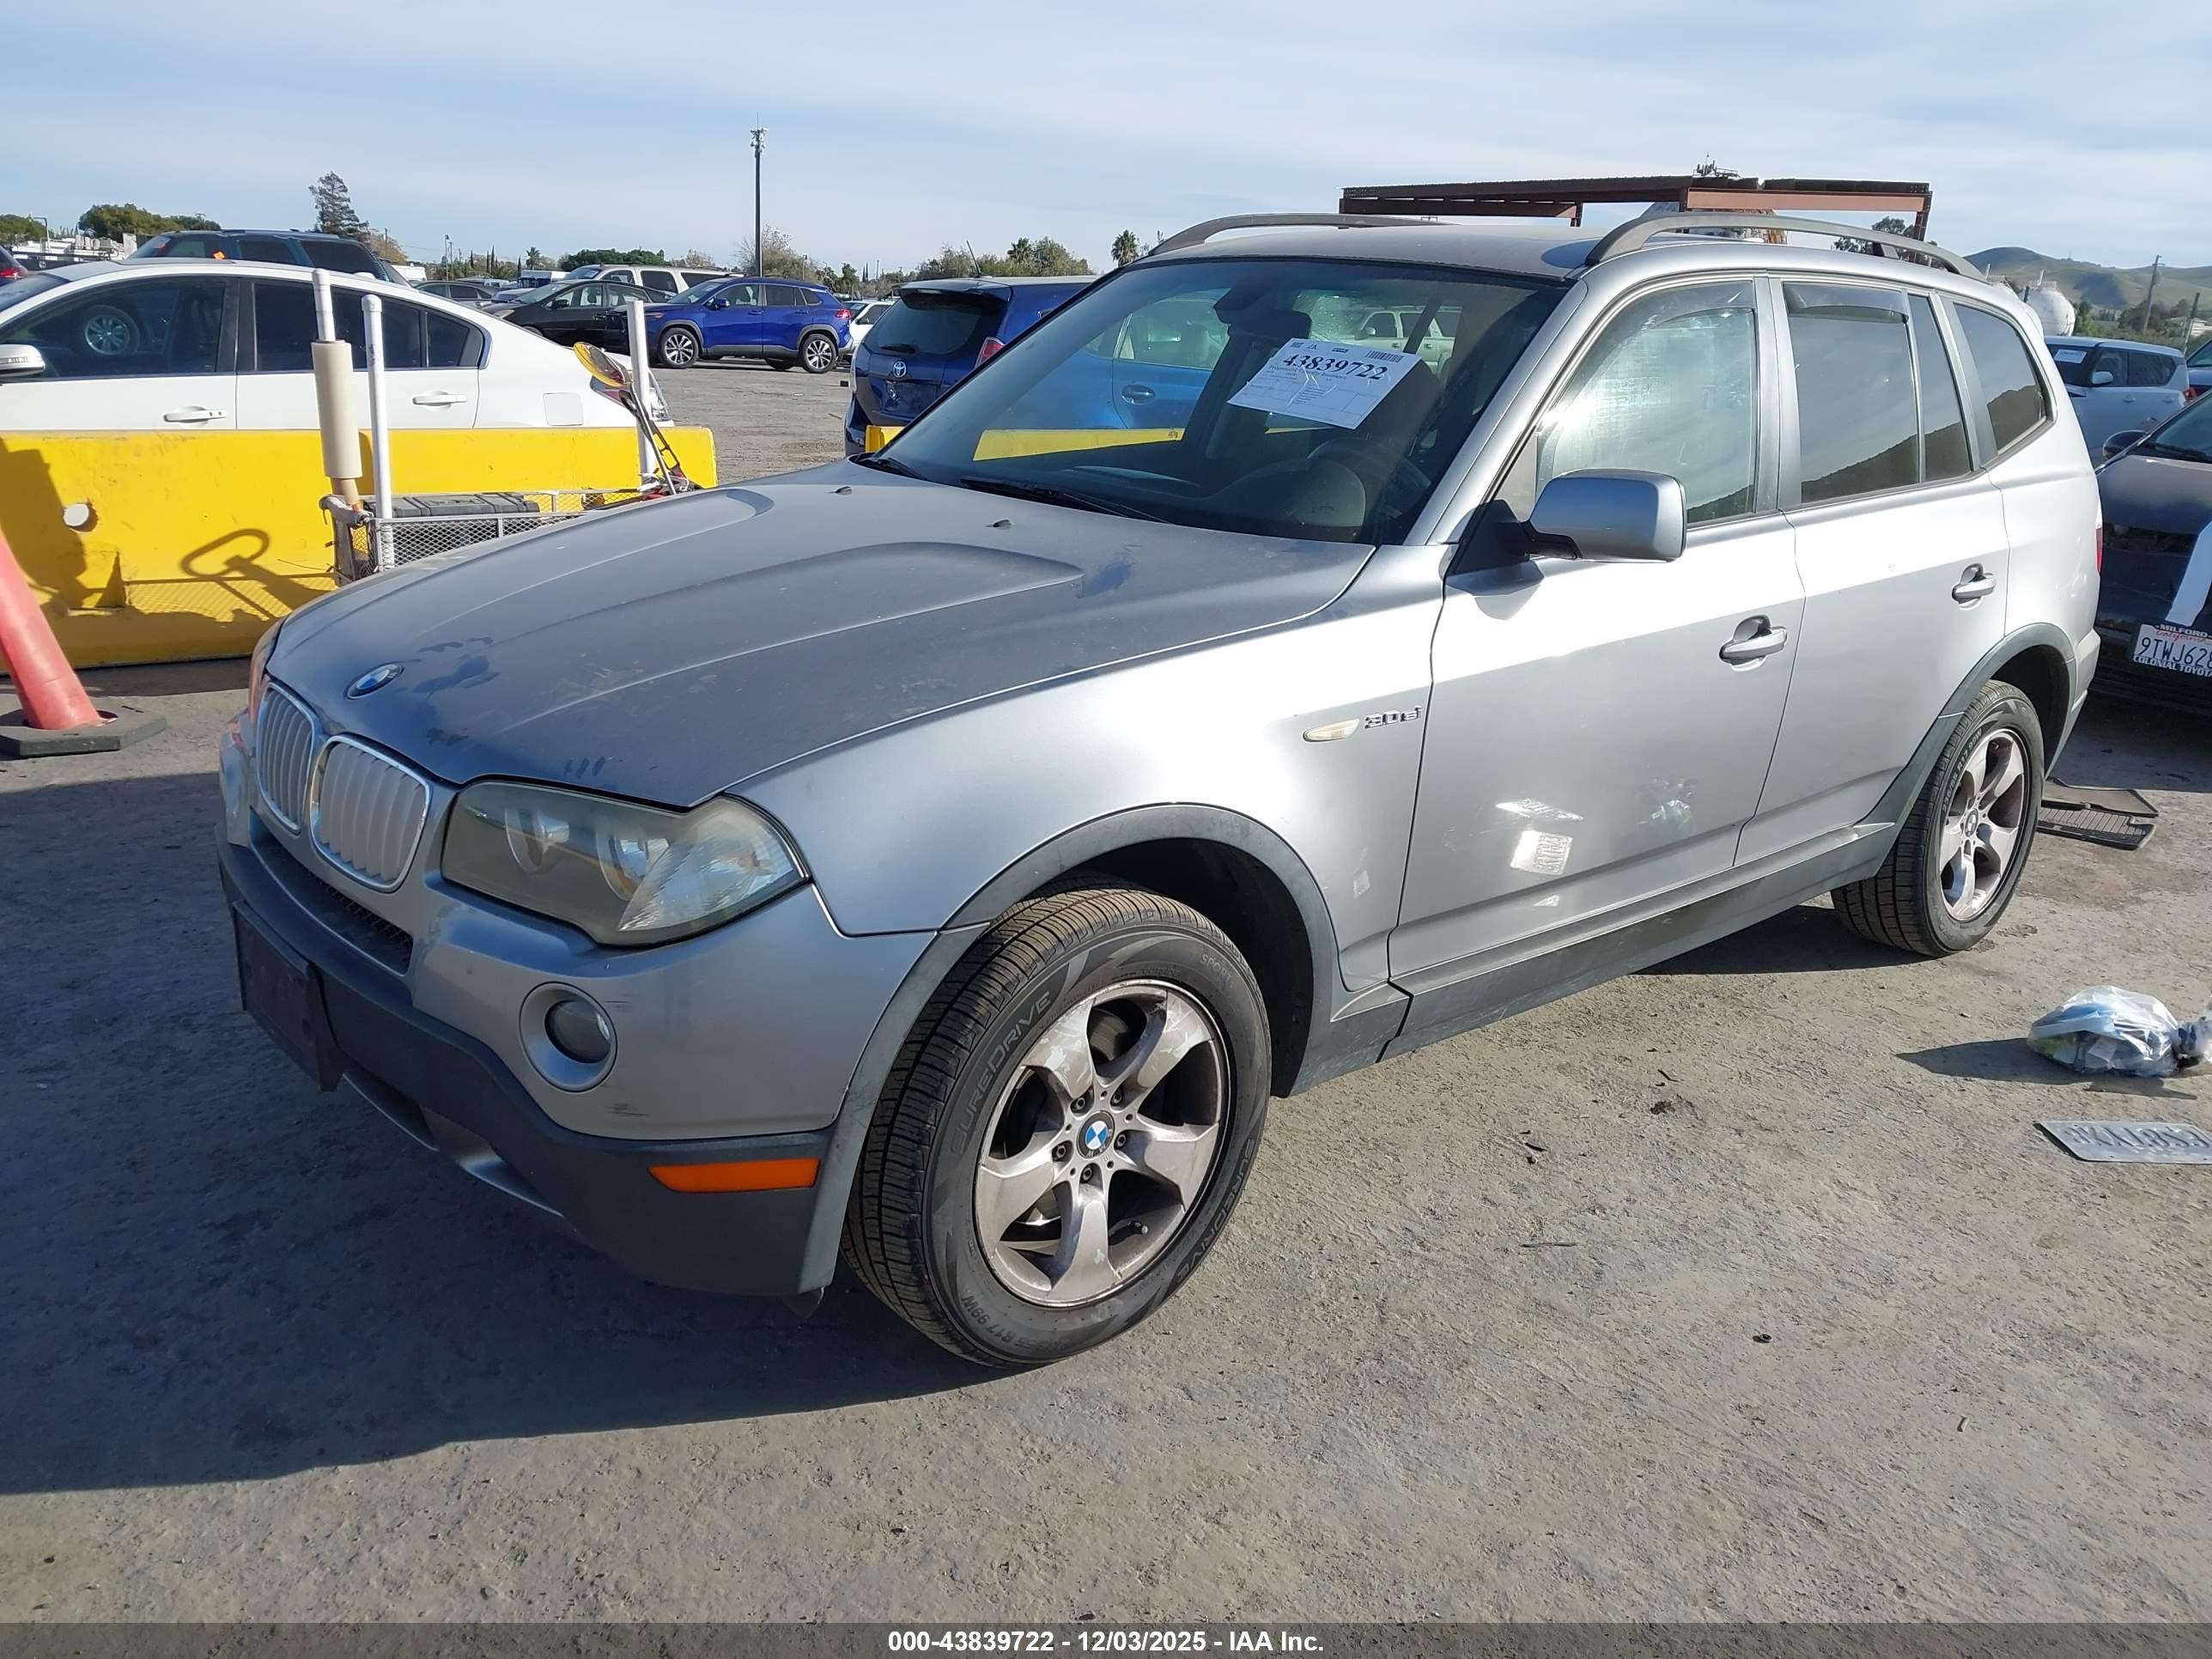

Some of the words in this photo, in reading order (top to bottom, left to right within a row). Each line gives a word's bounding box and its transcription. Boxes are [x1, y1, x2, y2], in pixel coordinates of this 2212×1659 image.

[1283, 354, 1389, 380] 43839722
[2133, 655, 2178, 671] COLONIAL
[951, 991, 1051, 1156] SUREDRIVE
